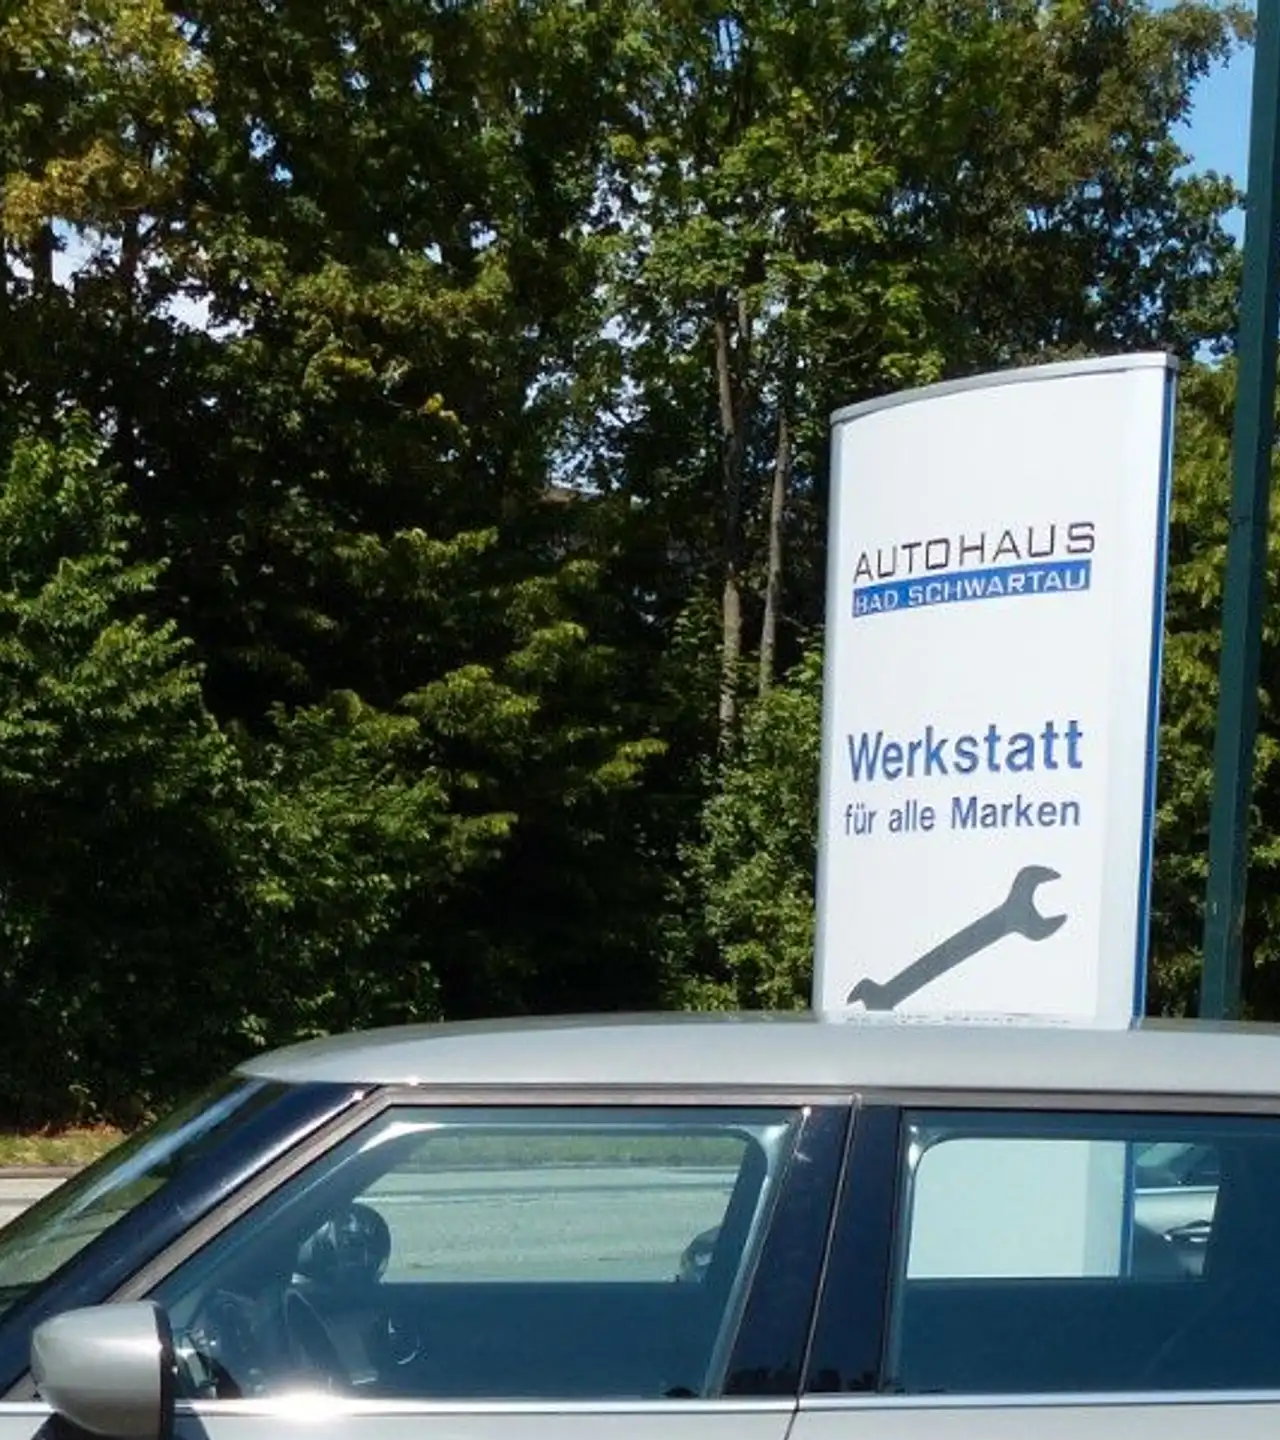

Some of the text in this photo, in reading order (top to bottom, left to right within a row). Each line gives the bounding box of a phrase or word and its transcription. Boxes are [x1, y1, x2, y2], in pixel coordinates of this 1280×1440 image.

[853, 522, 1096, 583] AUTOHAUS
[855, 568, 1087, 614] BAD SCHWARTAU
[847, 720, 1083, 782] Werkstatt
[844, 794, 1080, 835] für alle Marken
